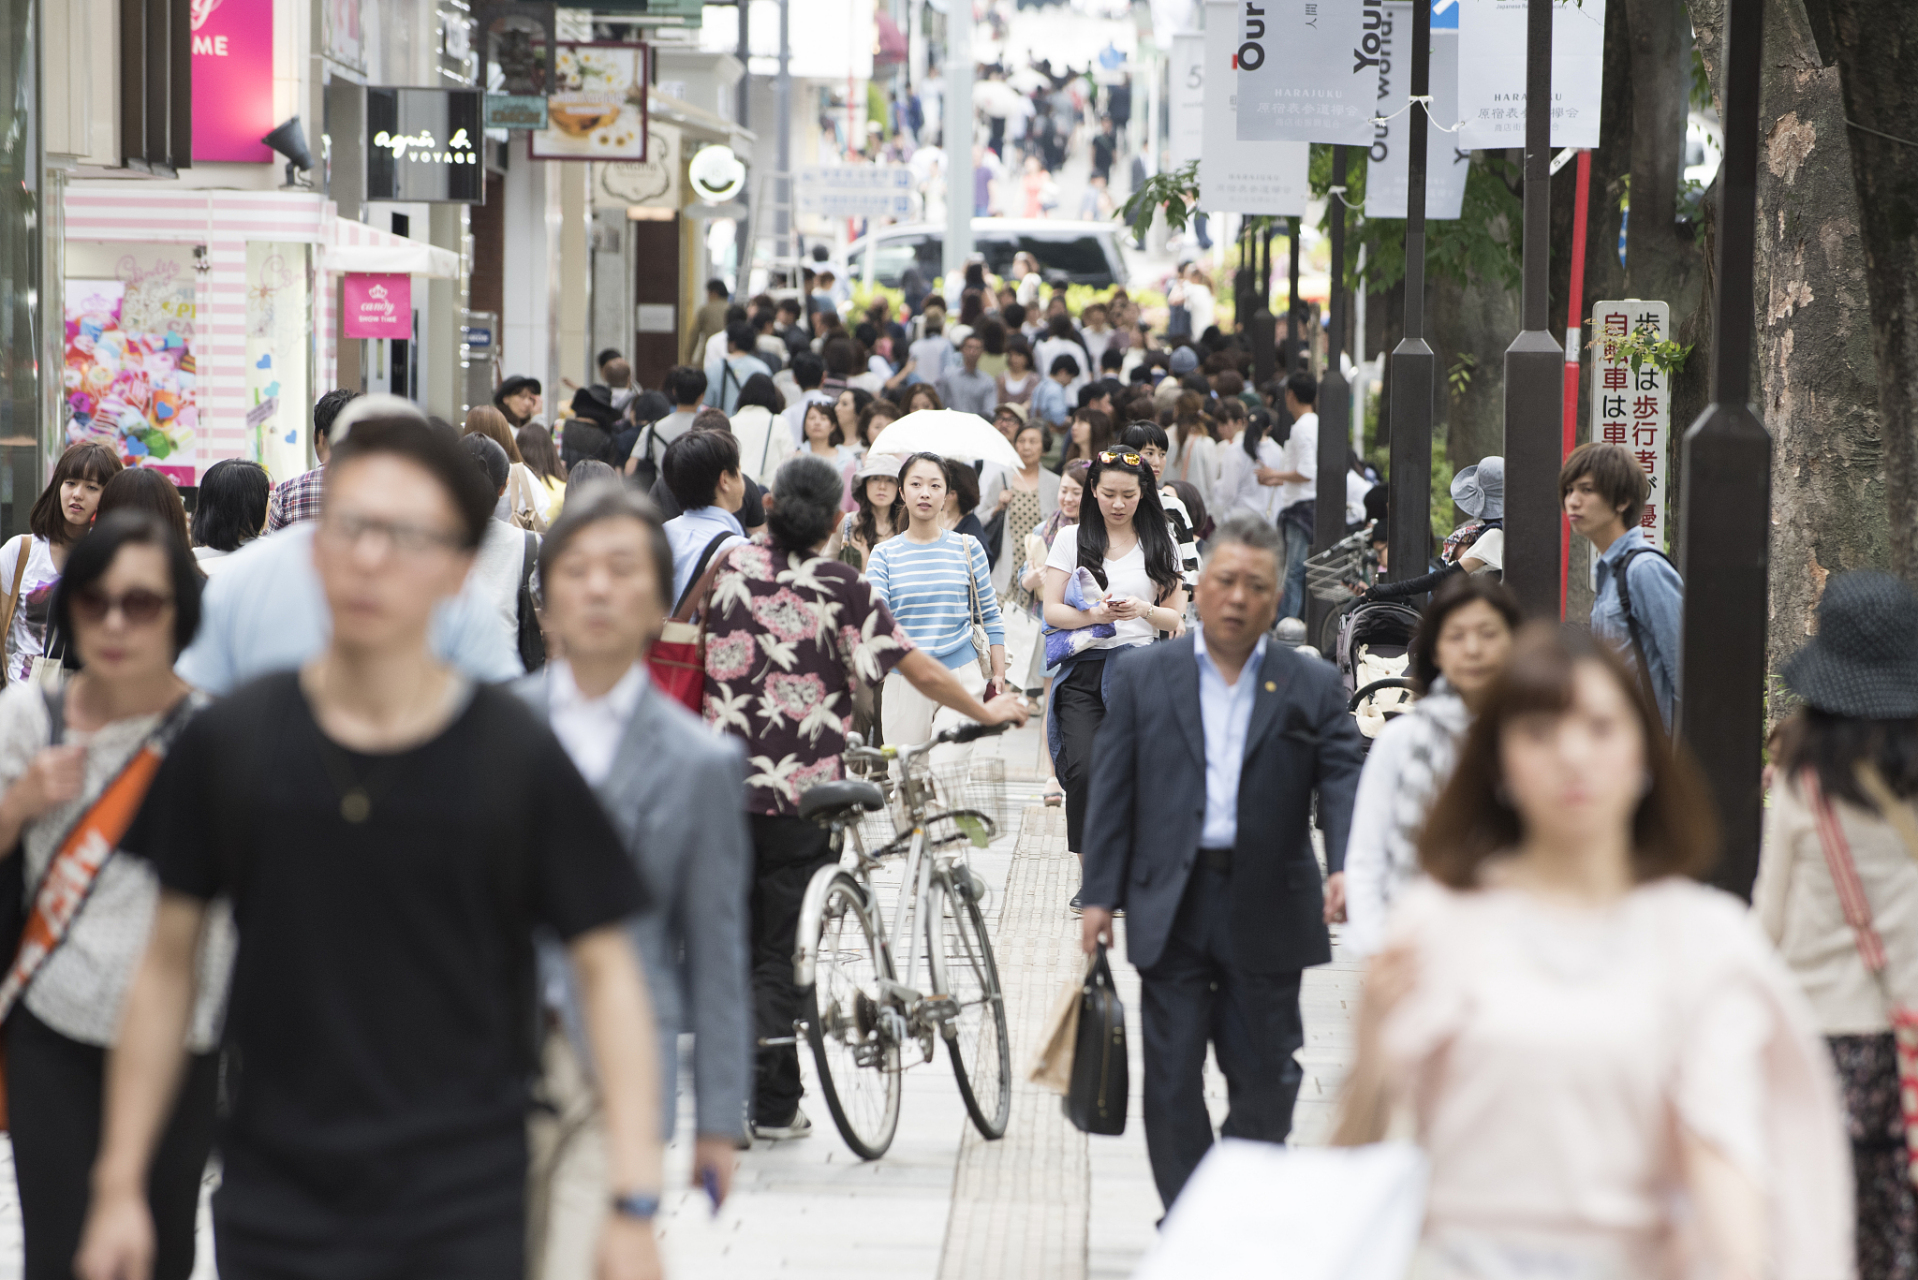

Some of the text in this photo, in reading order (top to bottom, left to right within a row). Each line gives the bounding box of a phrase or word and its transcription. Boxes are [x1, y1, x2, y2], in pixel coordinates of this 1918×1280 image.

[1238, 2, 1265, 71] Our
[1274, 88, 1343, 98] HARAJUKU
[1494, 93, 1562, 101] HARAU
[1478, 107, 1579, 119] 原宿表欅会
[408, 151, 476, 165] VOYAGE
[361, 299, 394, 316] candy
